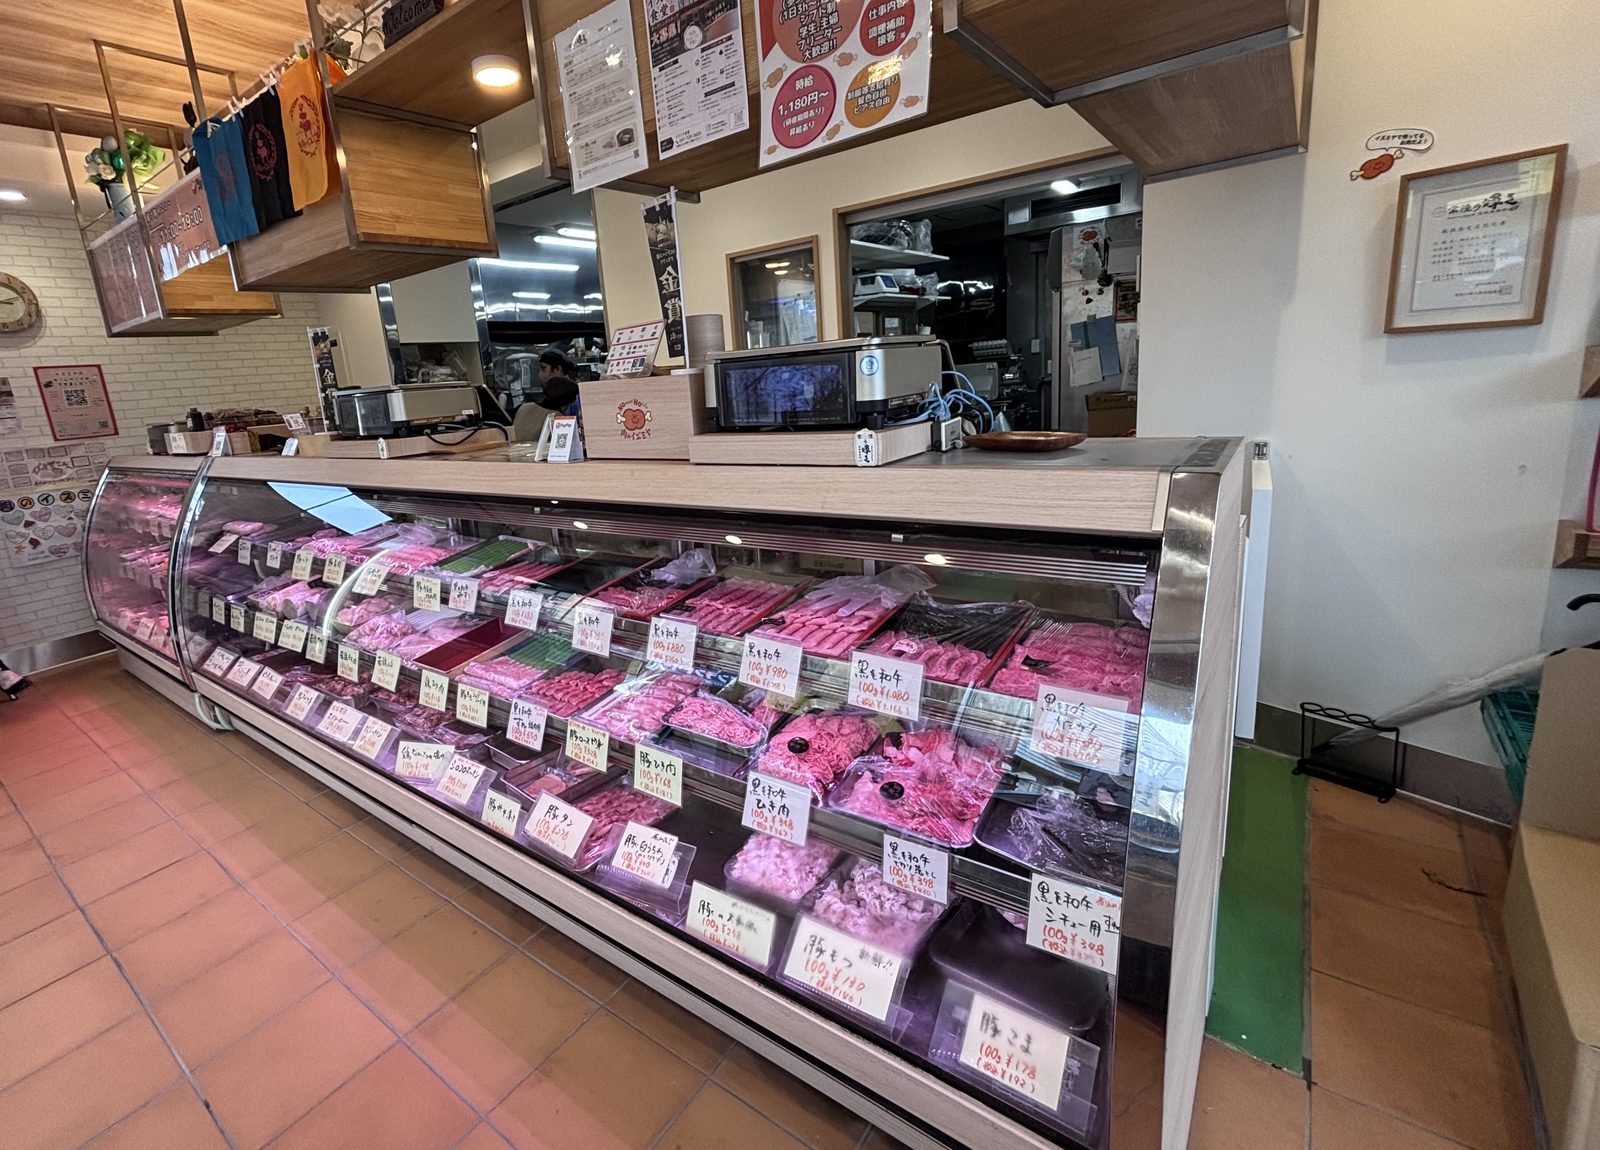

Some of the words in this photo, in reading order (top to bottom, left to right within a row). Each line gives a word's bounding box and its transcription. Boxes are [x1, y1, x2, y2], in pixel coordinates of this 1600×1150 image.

[797, 27, 842, 51] フリーター
[803, 38, 837, 61] 大歓迎!!
[877, 31, 896, 48] 接客
[795, 75, 814, 91] 時給
[854, 97, 890, 115] ピアス自由
[659, 265, 682, 324] 金賞
[755, 798, 790, 818] ひき肉
[1035, 880, 1093, 912] 黒毛和牛
[804, 934, 853, 968] 豚もつ
[1043, 925, 1068, 945] 100g
[1071, 933, 1104, 956] ¥348
[980, 1010, 1033, 1056] 豚こま
[980, 1042, 1002, 1064] 100g
[1006, 1052, 1036, 1080] ¥178
